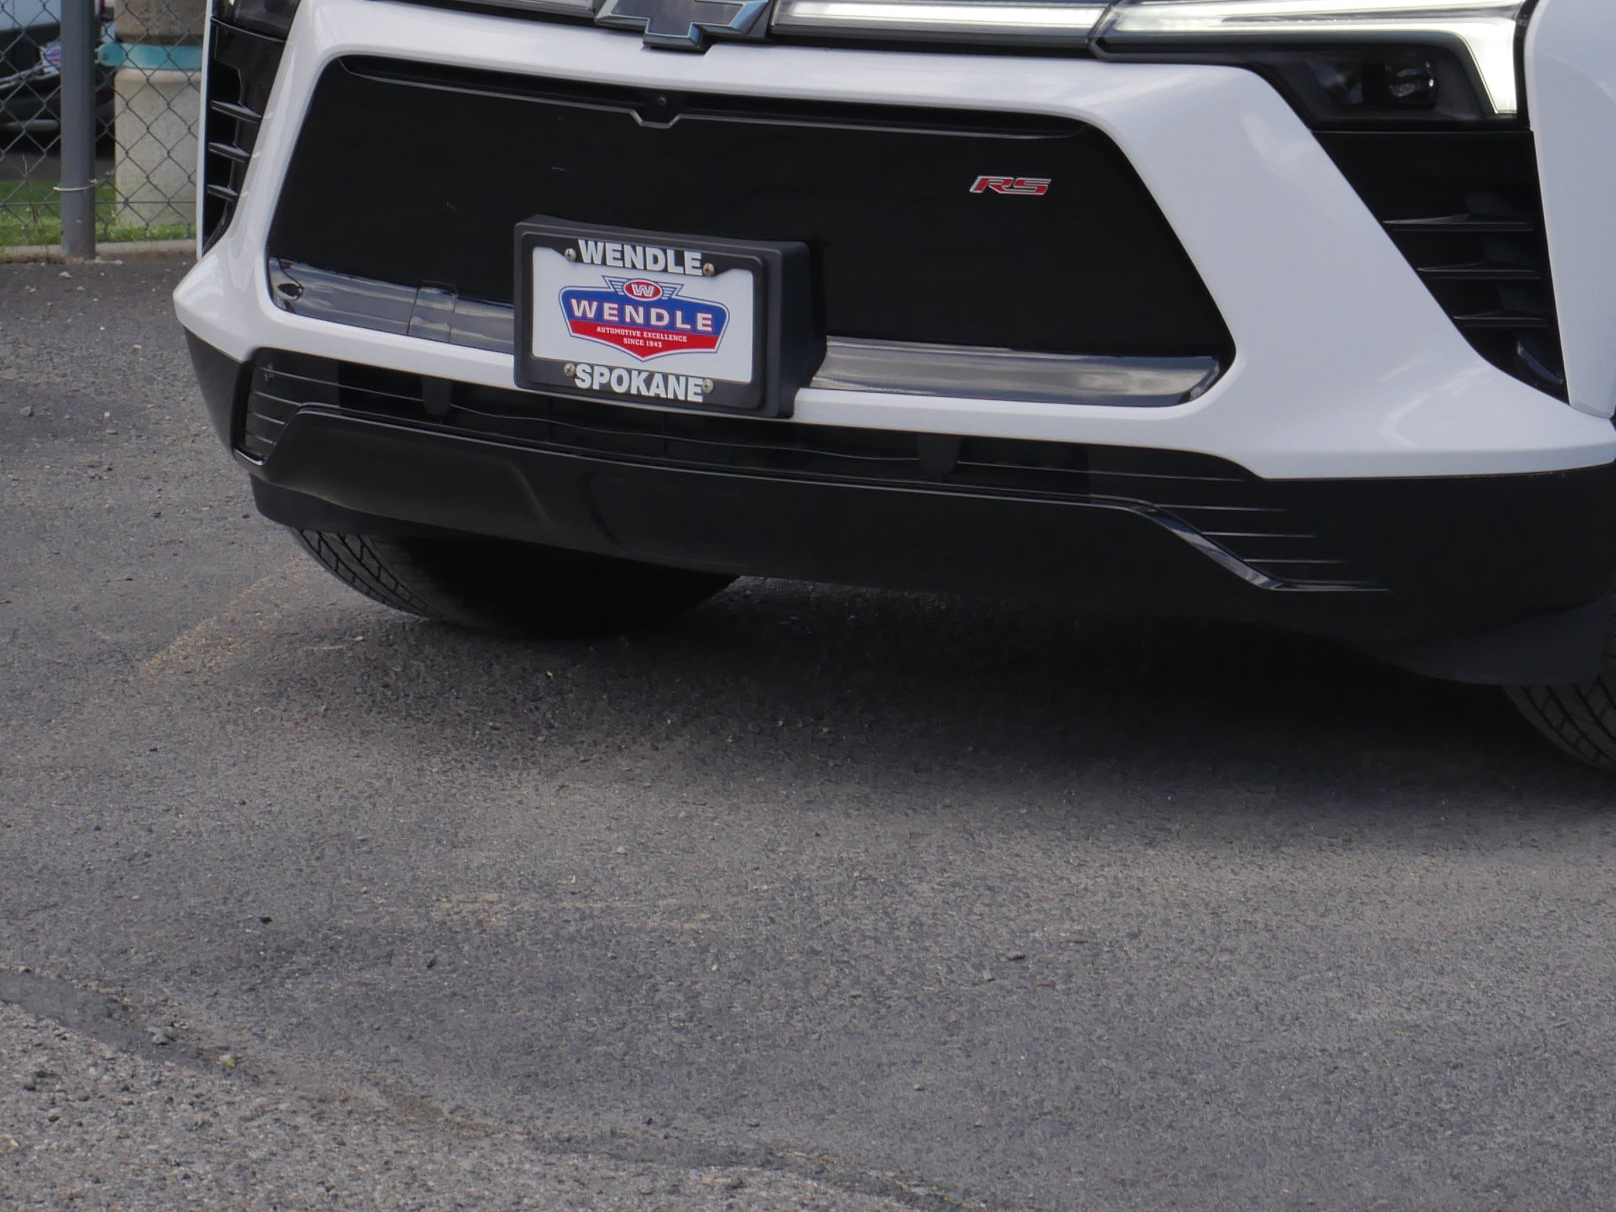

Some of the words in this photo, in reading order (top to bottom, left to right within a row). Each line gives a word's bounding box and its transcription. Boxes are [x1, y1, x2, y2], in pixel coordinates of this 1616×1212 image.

[969, 175, 1052, 196] RS
[578, 239, 703, 276] WENDLE
[571, 298, 713, 332] WENDLE
[596, 326, 641, 338] AUTOMOTIVE
[643, 331, 688, 343] EXCELLENCE
[623, 338, 645, 347] SINCE
[646, 340, 663, 348] 1943
[574, 363, 704, 403] SPOKANE
